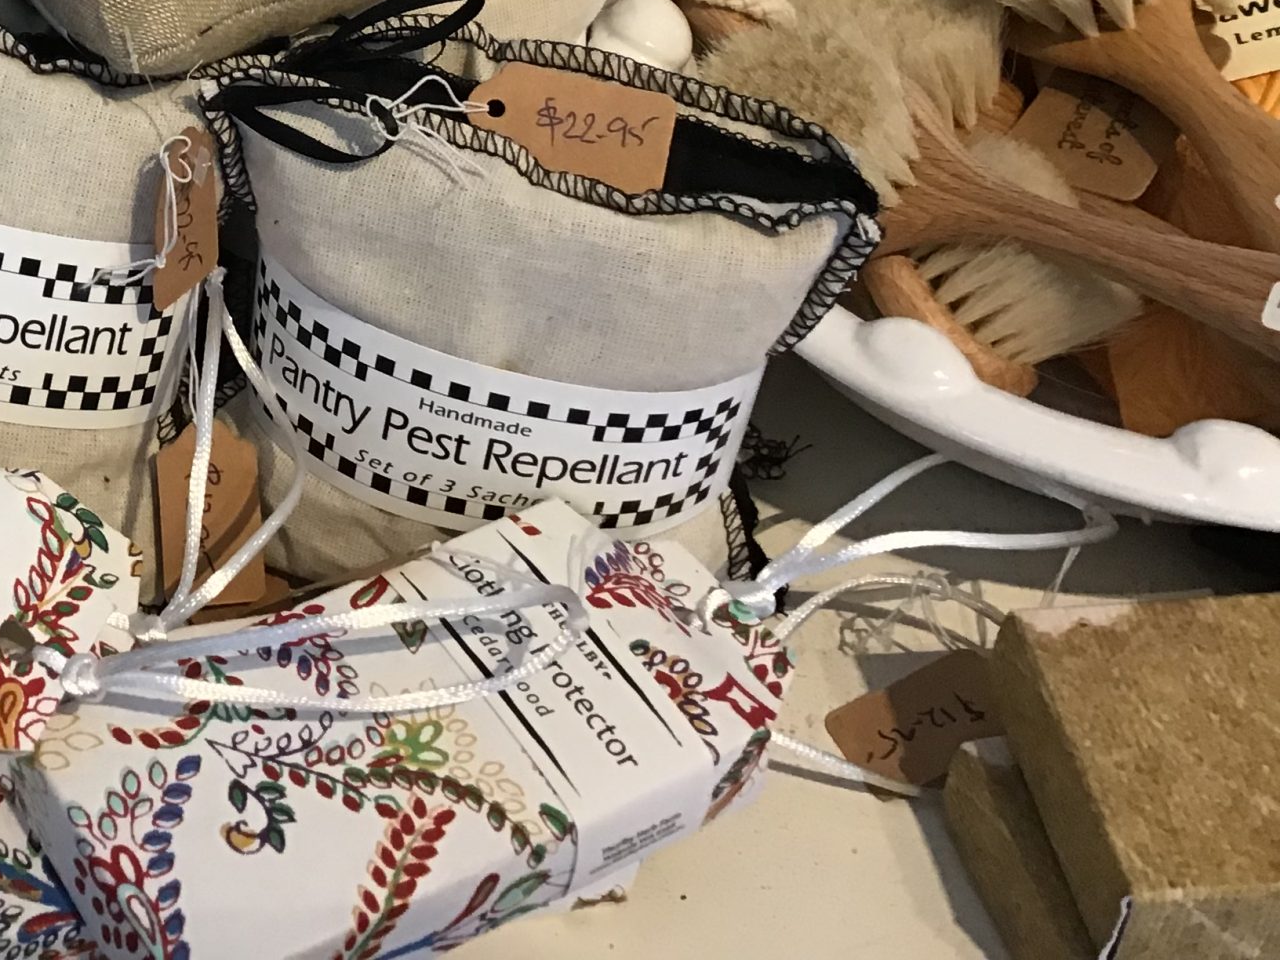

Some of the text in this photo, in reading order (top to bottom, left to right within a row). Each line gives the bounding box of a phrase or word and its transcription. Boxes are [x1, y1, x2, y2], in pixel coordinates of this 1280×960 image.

[267, 332, 690, 489] Pantry Pest Repellant
[418, 397, 534, 438] Handmade
[354, 447, 458, 495] Set of 3
[529, 646, 639, 769] rotector
